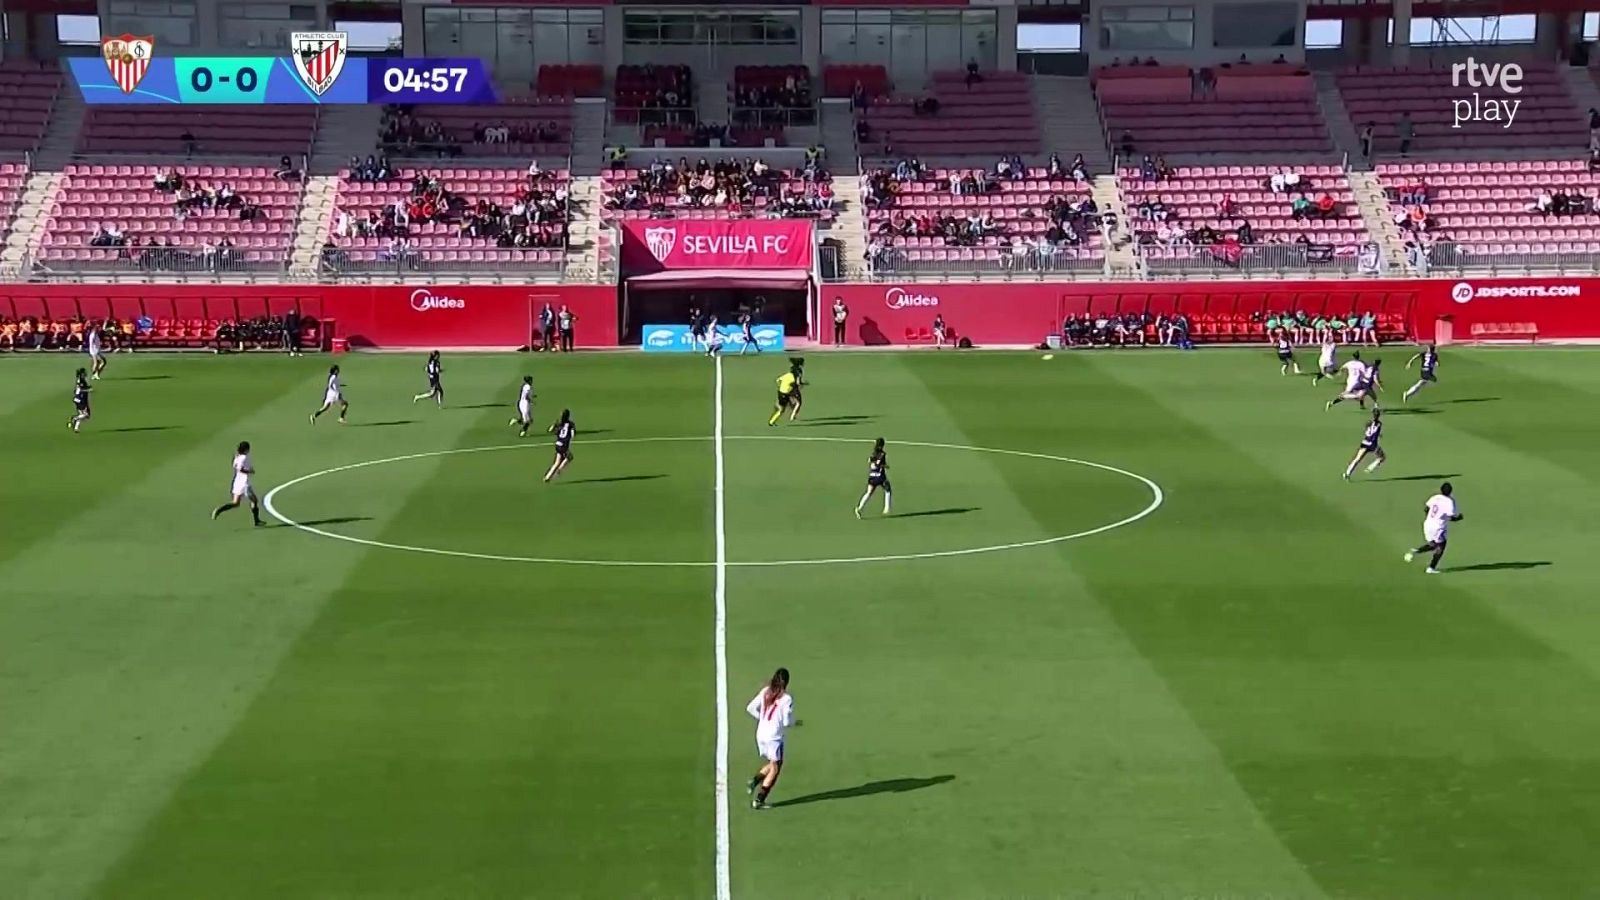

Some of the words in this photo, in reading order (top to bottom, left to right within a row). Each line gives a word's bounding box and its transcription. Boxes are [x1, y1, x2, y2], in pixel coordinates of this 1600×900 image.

[683, 235, 758, 254] SEVILLA
[763, 235, 788, 254] FC
[1474, 286, 1581, 297] JDSPORTS.COM
[420, 296, 465, 309] Midea
[896, 294, 939, 307] Midea
[1430, 504, 1439, 518] 9
